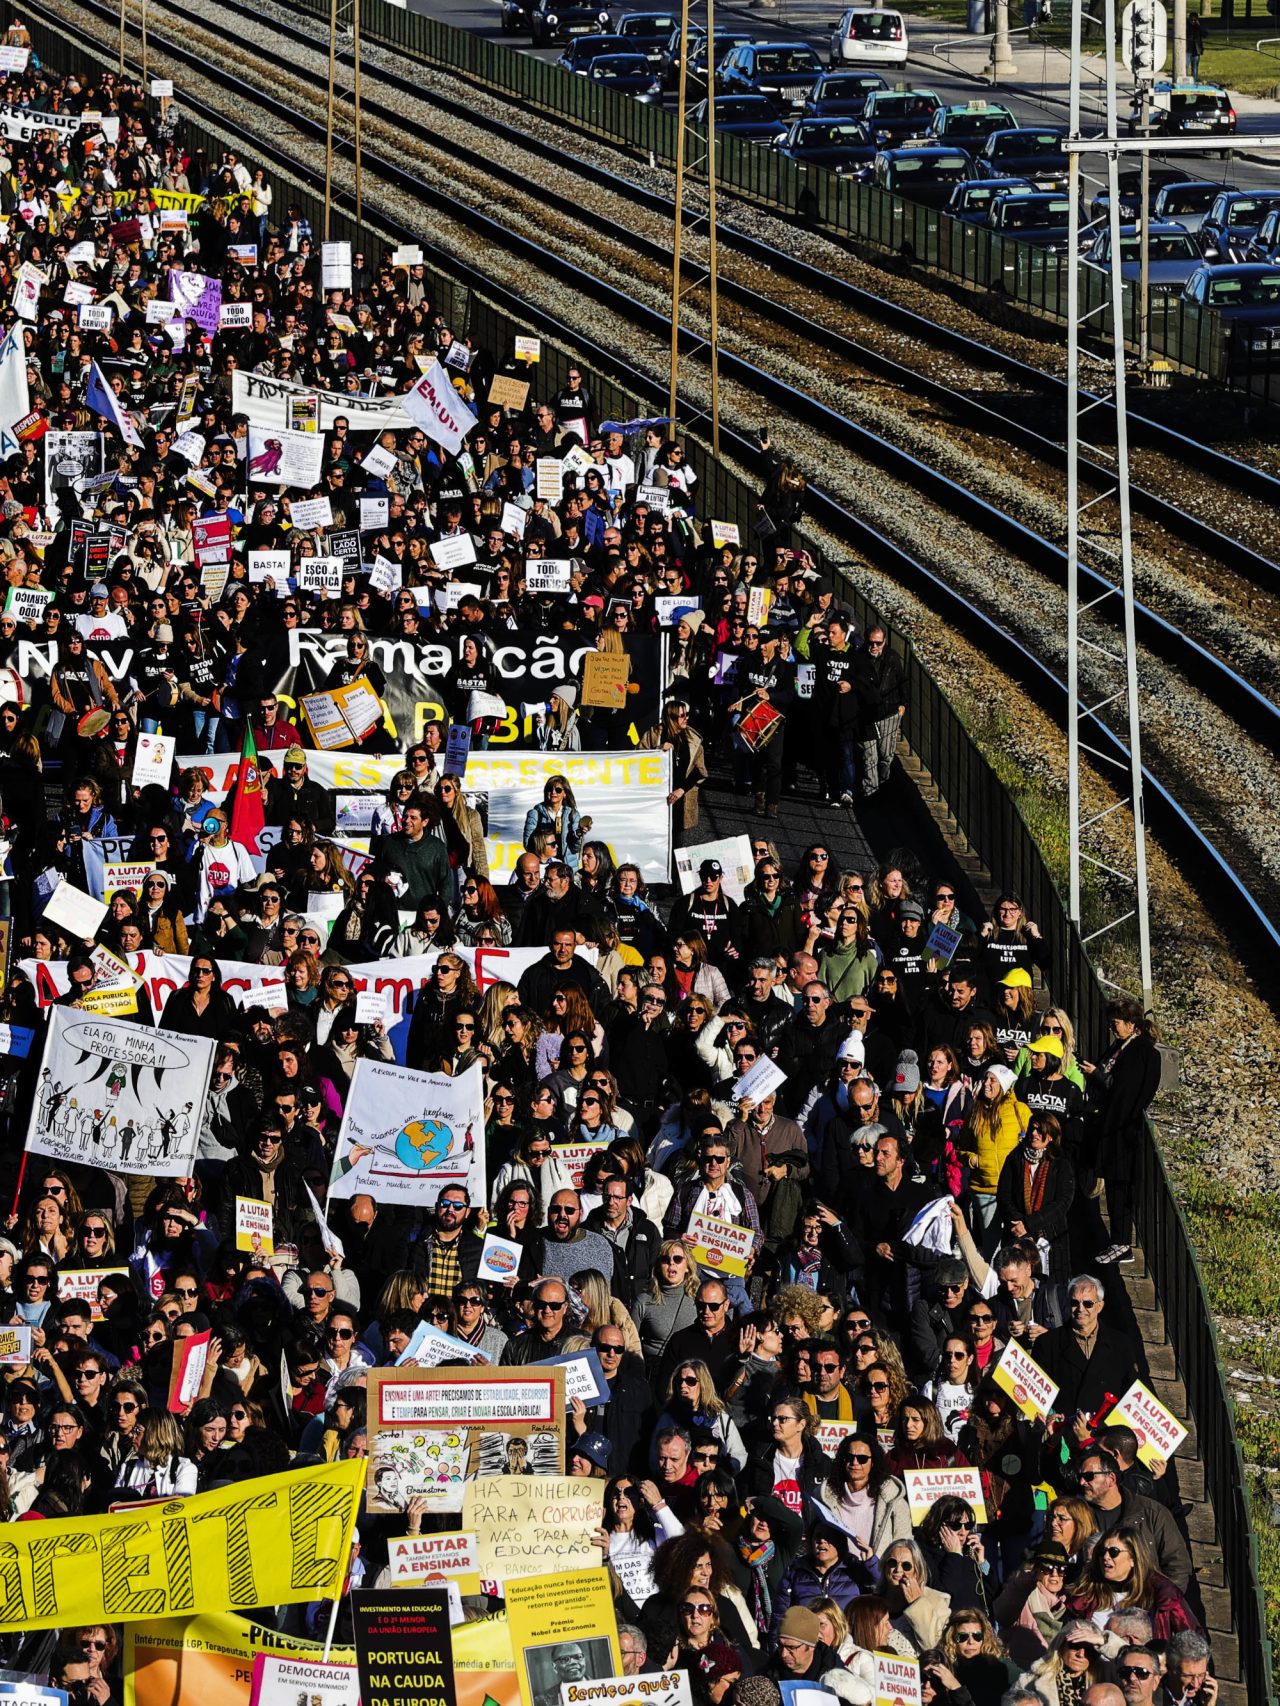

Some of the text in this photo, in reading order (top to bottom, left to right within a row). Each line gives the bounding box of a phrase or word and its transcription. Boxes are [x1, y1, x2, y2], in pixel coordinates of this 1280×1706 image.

[0, 102, 77, 130] REVOLUÇ
[89, 310, 105, 318] TODO
[334, 541, 357, 550] LADO
[334, 548, 358, 556] CERTO
[254, 561, 286, 569] BASTA!
[306, 565, 338, 575] ESCOA
[304, 576, 339, 587] PÚBLICA
[19, 607, 40, 618] TODO
[190, 659, 213, 671] ESTOU
[196, 673, 214, 683] LUTA
[198, 668, 209, 676] EM
[83, 1027, 155, 1054] ELA FOI MINHA
[91, 1041, 166, 1066] PROFESSORA!!
[1028, 1093, 1066, 1106] BASTA!
[88, 1157, 117, 1170] ADVOGADA
[695, 1219, 747, 1242] A LUTAR
[693, 1232, 745, 1255] A ENSINAR
[707, 1252, 722, 1261] STOP
[1010, 1349, 1053, 1396] A LUTAR
[1005, 1359, 1048, 1407] A ENSINAR
[406, 1485, 448, 1495] Brainstorm
[474, 1479, 592, 1498] HÁ DINHEIRO
[472, 1503, 538, 1523] PARA A
[490, 1527, 591, 1544] NÃO PARA A
[396, 1537, 468, 1557] A LUTAR
[495, 1541, 590, 1558] EDUCAÇÃO
[398, 1557, 471, 1573] A ENSINAR
[544, 1581, 564, 1590] nunca
[566, 1579, 575, 1587] foi
[536, 1591, 546, 1599] foi
[546, 1587, 591, 1599] investimento
[592, 1585, 606, 1593] com
[411, 1605, 443, 1613] EDUCAÇÃO
[528, 1600, 553, 1610] retorno
[380, 1625, 401, 1634] UNIÃO
[531, 1629, 551, 1637] Nobel
[563, 1623, 596, 1632] Economia
[368, 1651, 443, 1664] PORTUGAL
[278, 1663, 351, 1682] DEMOCRACIA
[370, 1675, 445, 1689] NA CAUDA
[568, 1673, 681, 1702] Serviços quê?
